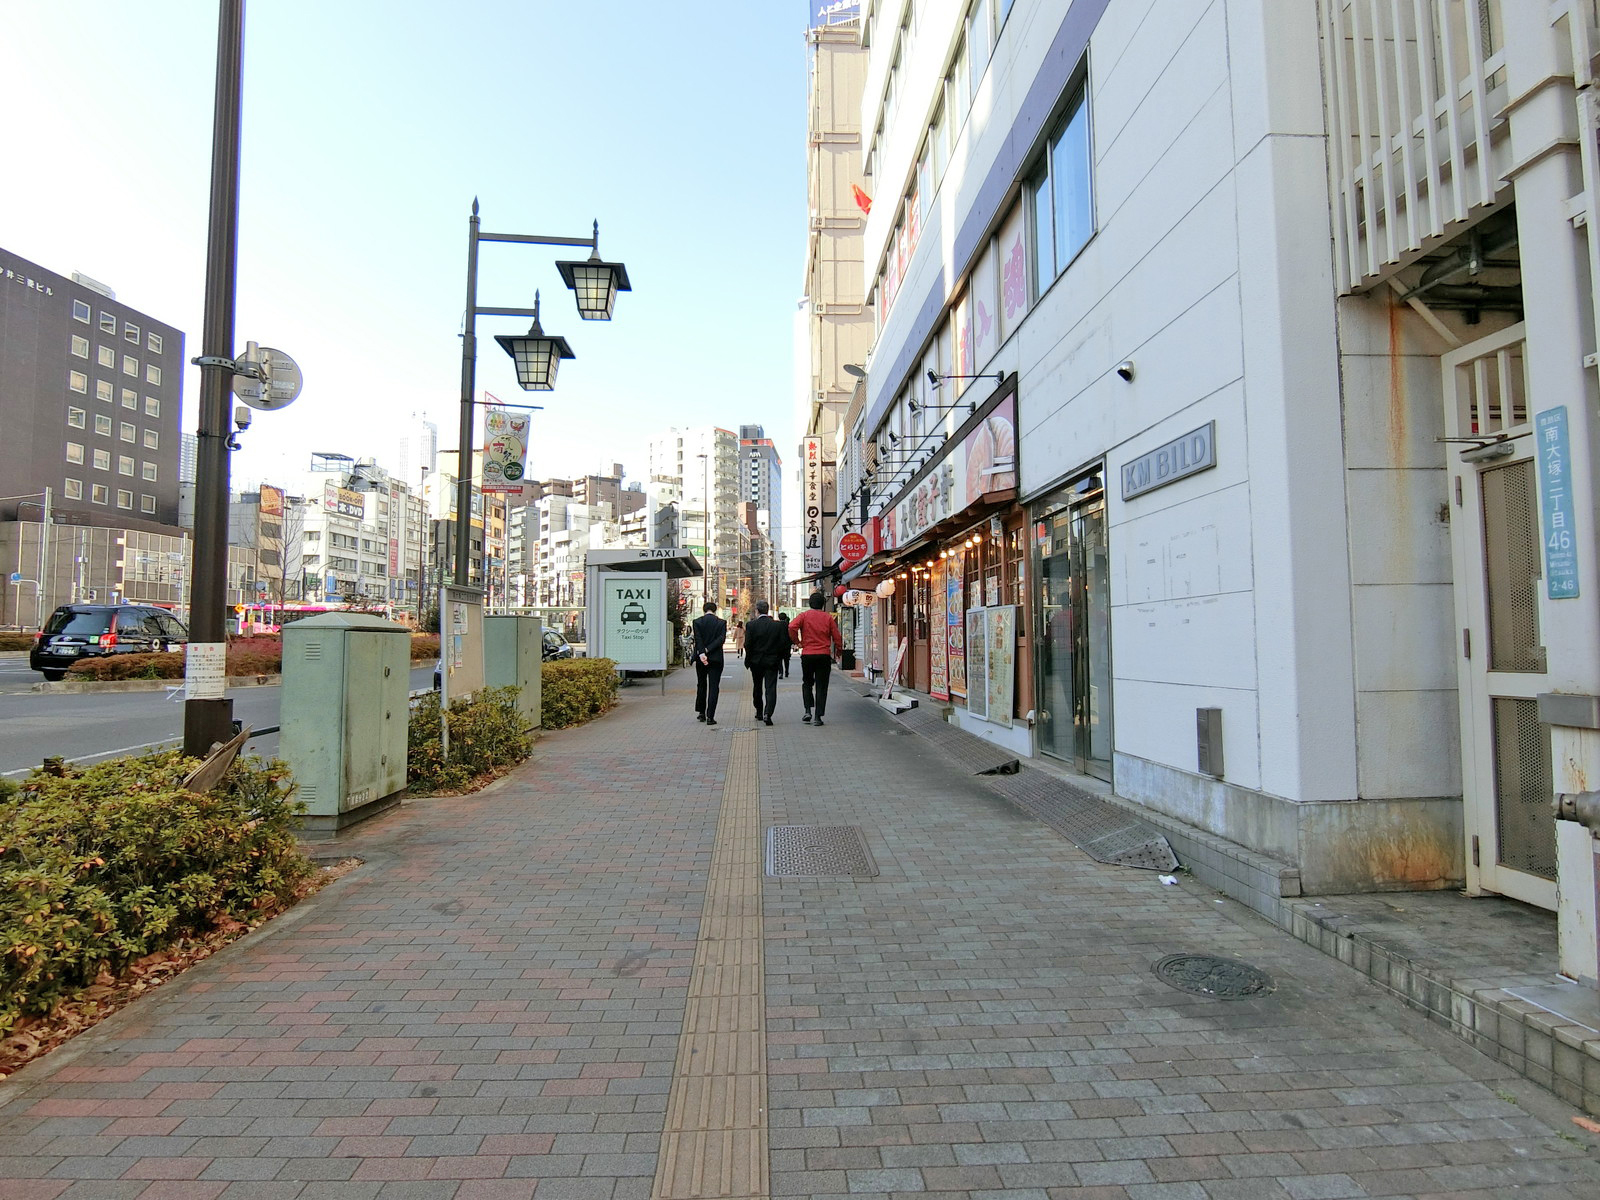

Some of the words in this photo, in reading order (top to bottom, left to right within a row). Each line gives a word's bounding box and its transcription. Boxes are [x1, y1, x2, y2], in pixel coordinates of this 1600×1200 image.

[808, 441, 818, 501] 熱烈中華食堂
[1126, 458, 1151, 493] KM
[1156, 434, 1206, 480] BILD
[1544, 426, 1565, 528] 南大塚二丁目
[900, 464, 955, 542] 大塚餃子軒
[806, 506, 821, 549] 日高屋
[1548, 530, 1570, 550] 46
[651, 549, 675, 558] TAXI
[616, 588, 651, 600] TAXI
[1551, 580, 1574, 591] 2-46
